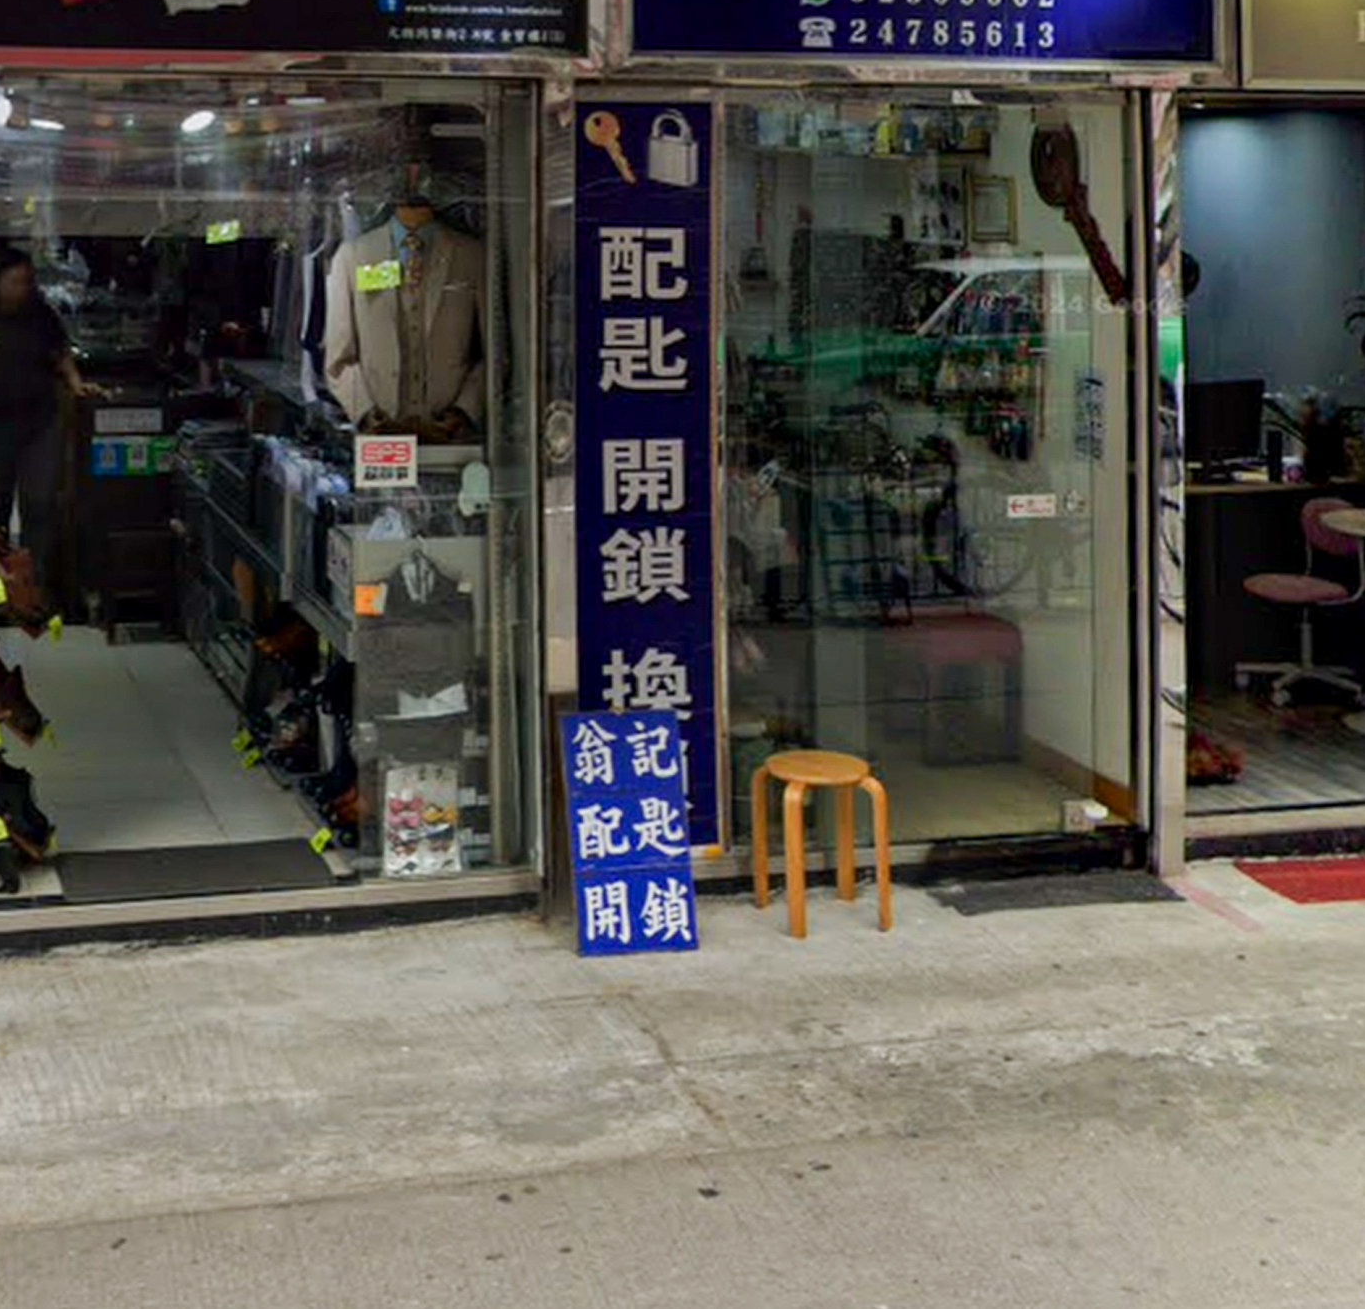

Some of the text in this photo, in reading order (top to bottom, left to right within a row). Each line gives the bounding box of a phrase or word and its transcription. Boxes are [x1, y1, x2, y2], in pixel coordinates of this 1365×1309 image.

[848, 17, 1056, 48] 24785613
[598, 227, 689, 392] 配匙
[599, 438, 690, 603] 開鎖
[572, 719, 679, 785] 翁記
[577, 796, 688, 861] 配匙
[584, 877, 692, 944] 開鎖
